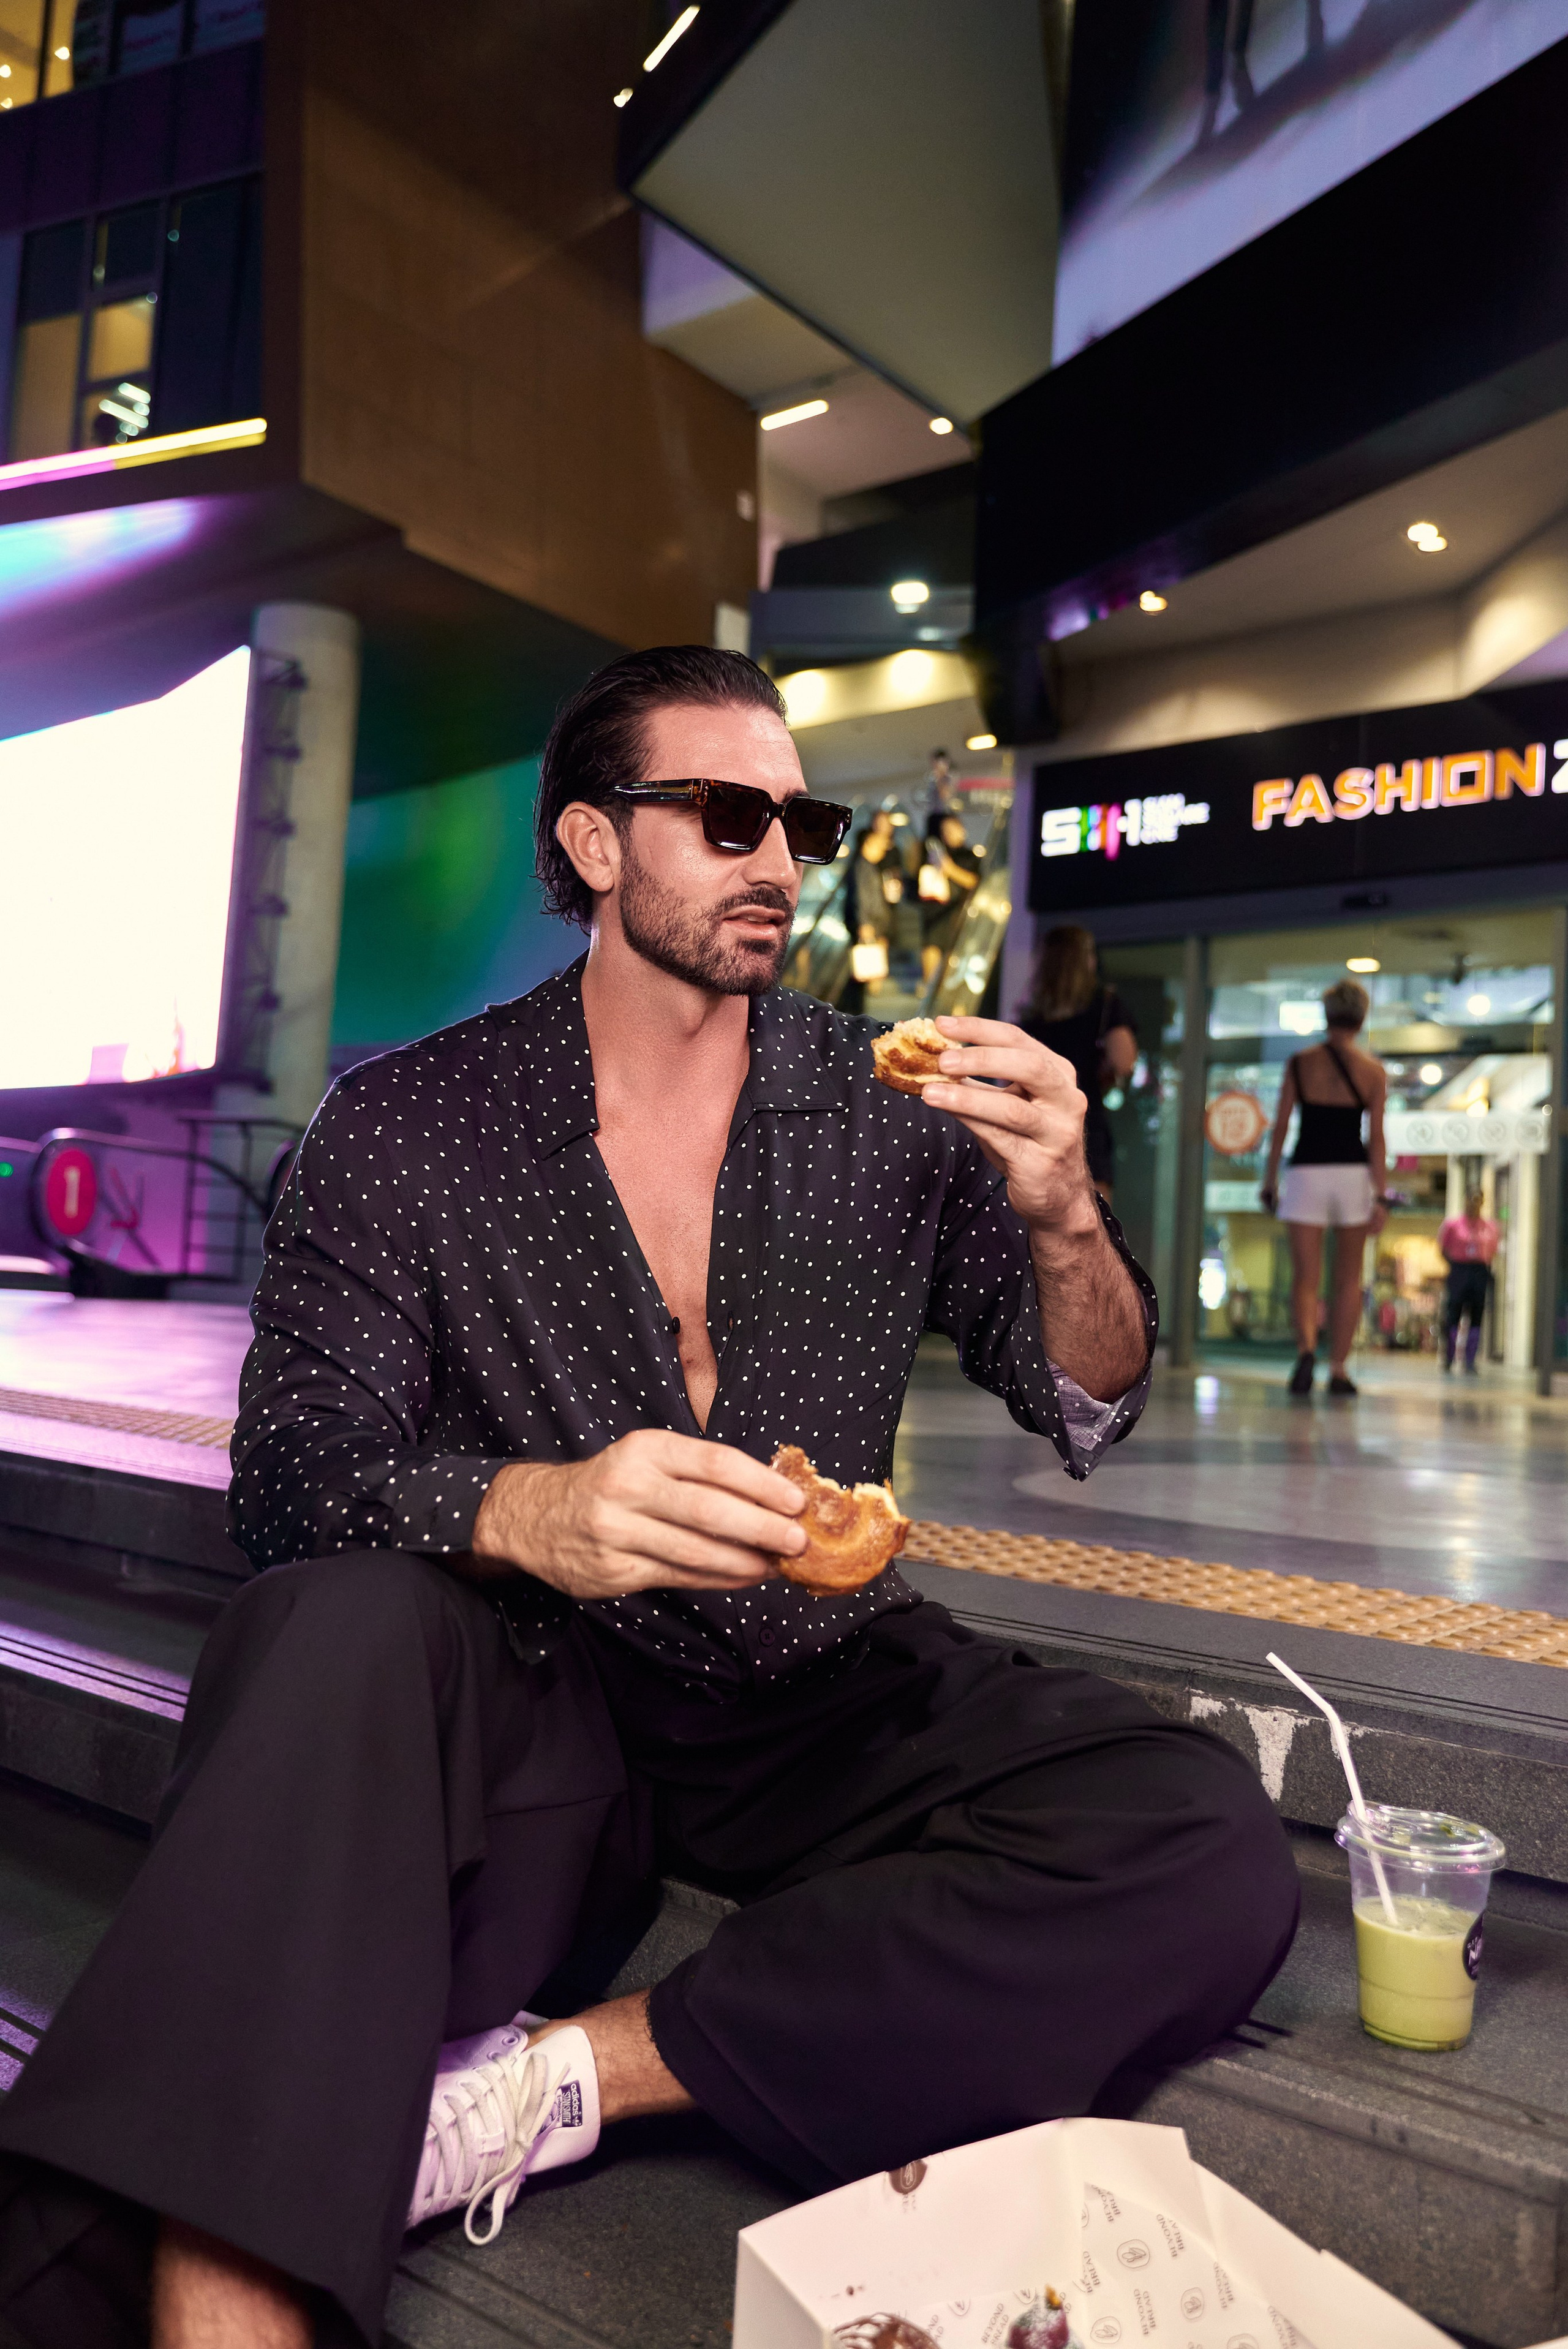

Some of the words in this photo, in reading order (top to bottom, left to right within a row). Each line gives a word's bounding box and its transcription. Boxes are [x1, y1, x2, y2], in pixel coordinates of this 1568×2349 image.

[1252, 742, 1546, 831] FASHION
[571, 2083, 579, 2116] adidas
[1156, 2214, 1177, 2257] BEYOND
[1167, 2218, 1184, 2250] BREA
[1082, 2250, 1101, 2286] BREAD
[981, 2302, 1005, 2344] BEYOND
[1134, 2289, 1148, 2335] BEYOND
[1143, 2291, 1156, 2328] BREAD
